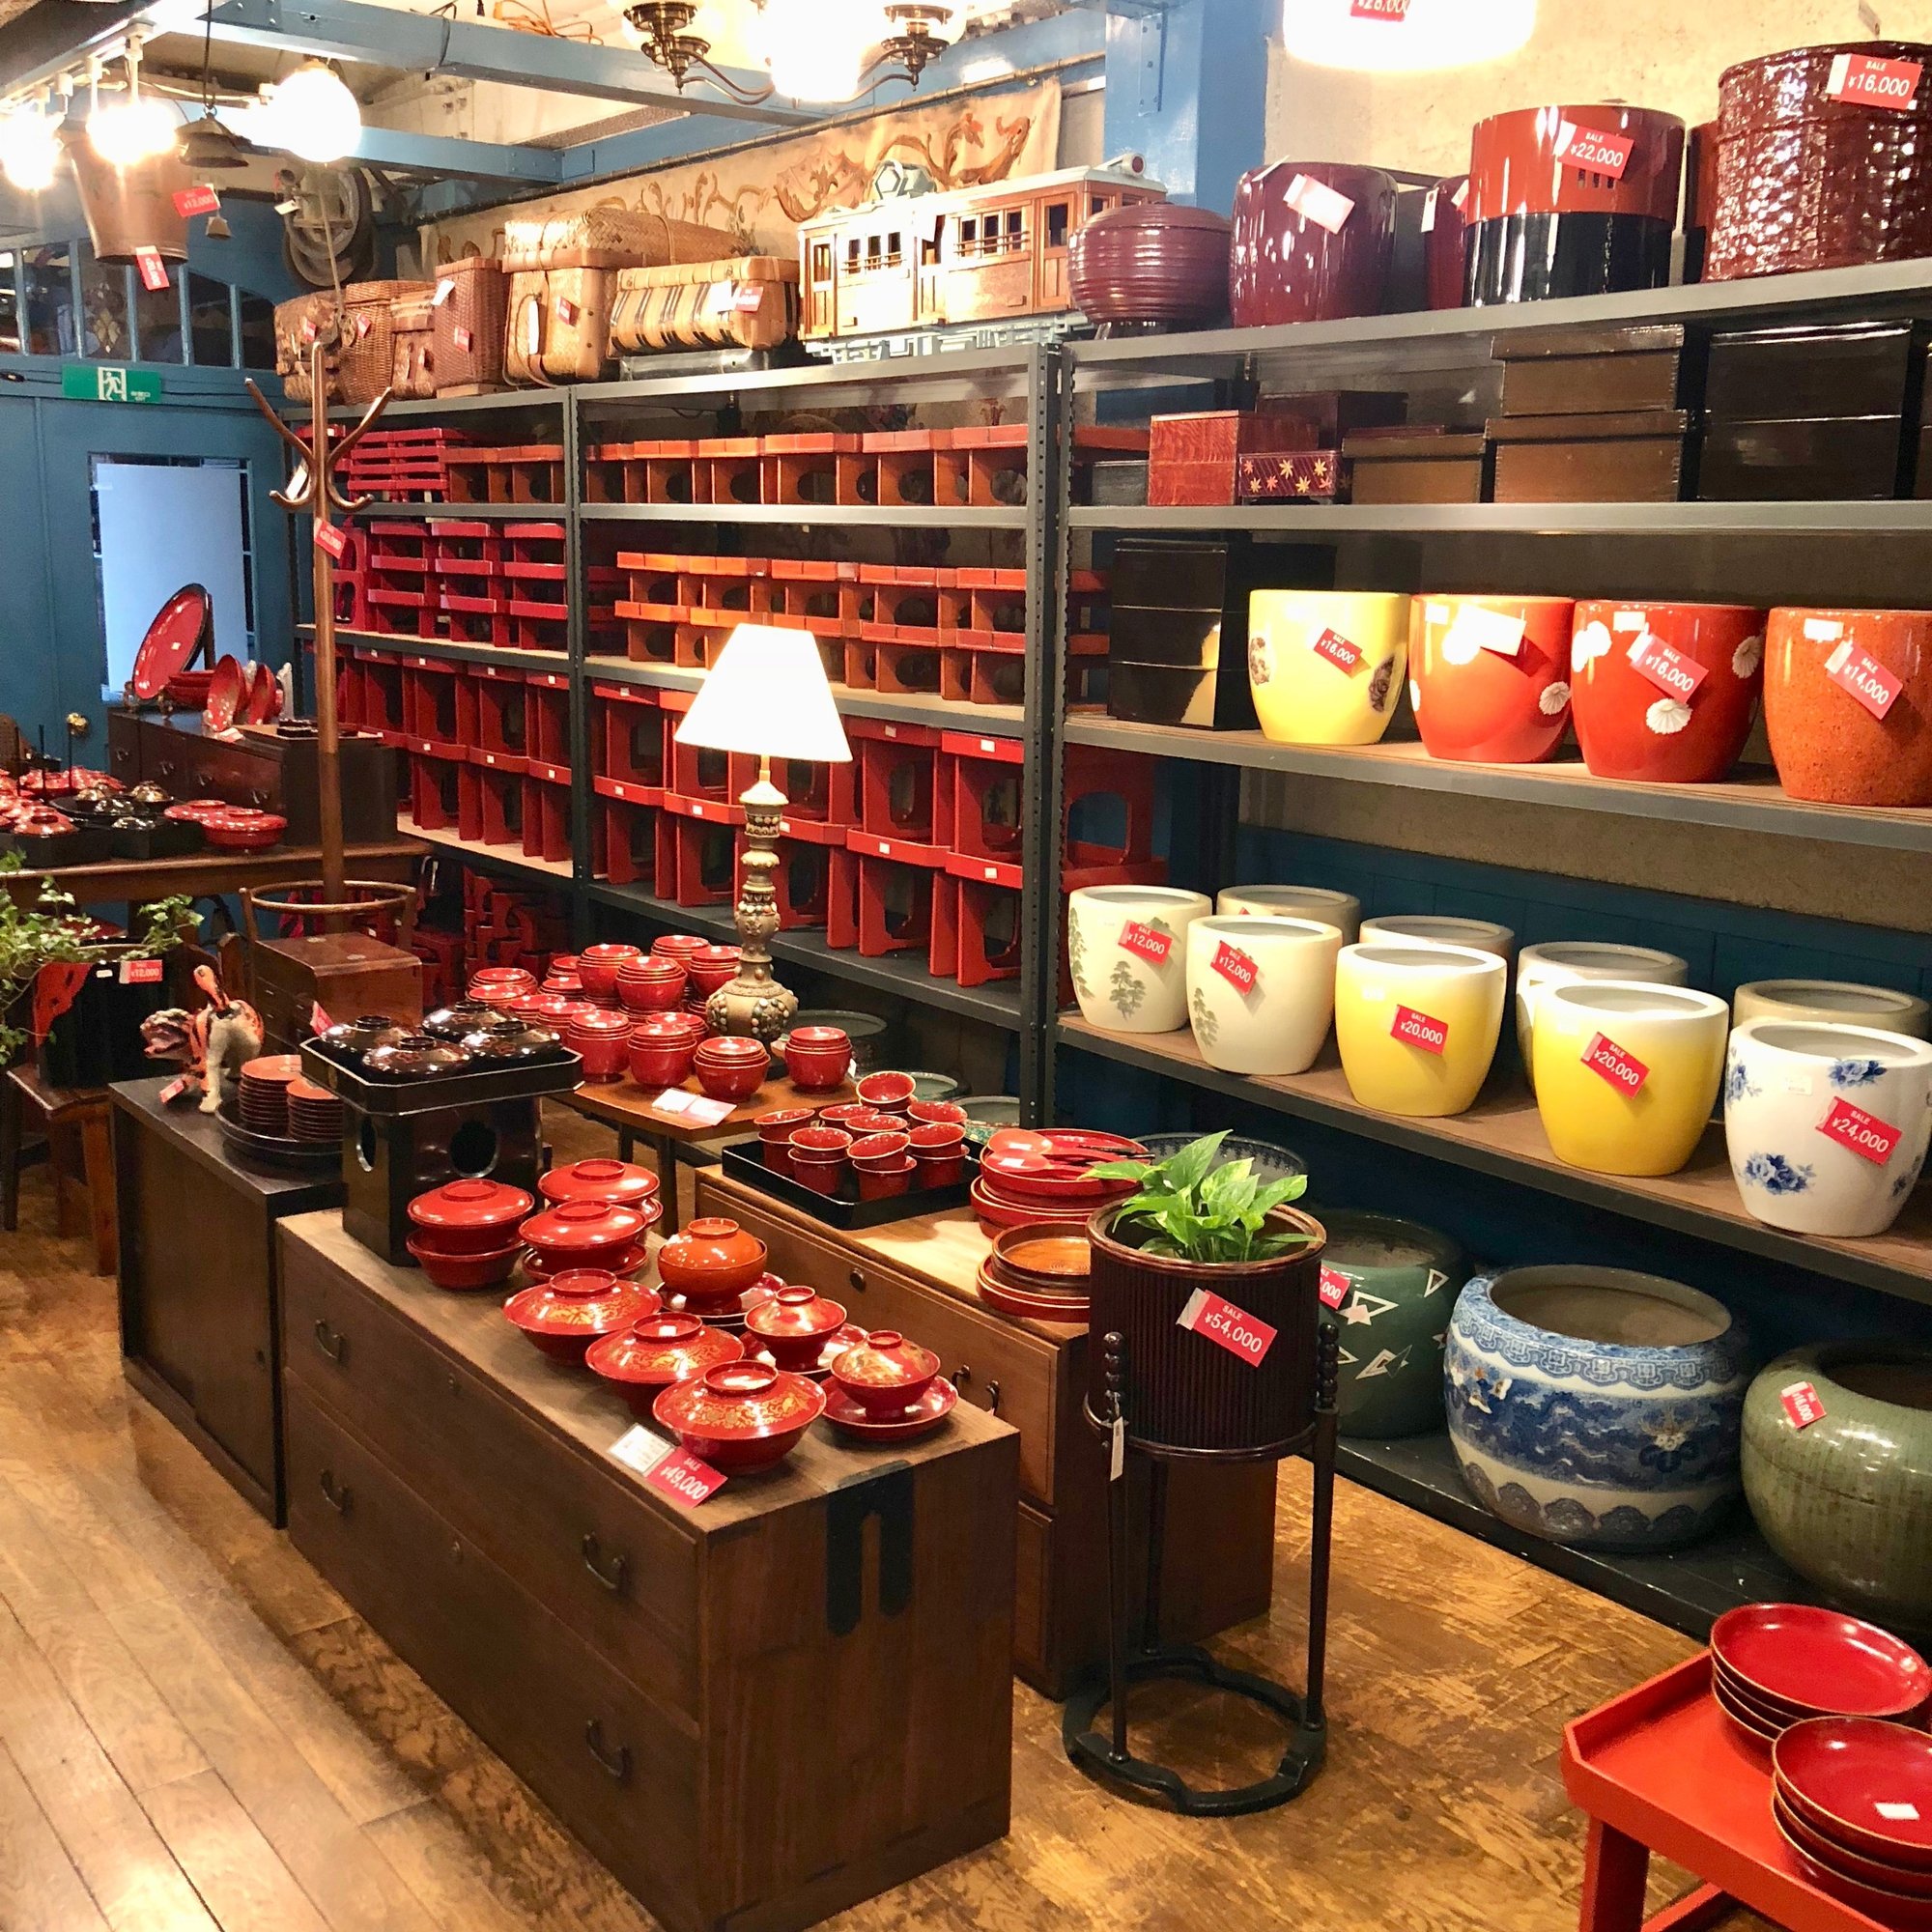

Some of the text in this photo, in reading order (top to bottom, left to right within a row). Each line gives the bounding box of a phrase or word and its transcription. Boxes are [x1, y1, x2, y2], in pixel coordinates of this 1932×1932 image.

[1866, 60, 1888, 71] SALE
[1847, 73, 1911, 97] ¥16,000
[1585, 132, 1604, 143] SALE
[1570, 142, 1624, 167] ¥22,000
[1662, 648, 1681, 664] SALE
[1861, 657, 1878, 674] SALE
[1645, 655, 1694, 692] ¥16,000
[1843, 664, 1889, 705] ¥14,000
[1128, 932, 1165, 954] ¥12,000
[1219, 955, 1251, 983] ¥12,000
[1410, 1012, 1427, 1023] SALE
[1400, 1021, 1443, 1045] ¥20,000
[1608, 1043, 1627, 1059] SALE
[1593, 1049, 1639, 1086] ¥20,000
[1850, 1110, 1871, 1124] SALE
[1832, 1117, 1889, 1153] ¥24,000
[1222, 1304, 1244, 1321] SALE
[1205, 1313, 1263, 1353] ¥54,000
[684, 1457, 702, 1472] SALE
[659, 1465, 709, 1500] ¥49,000
